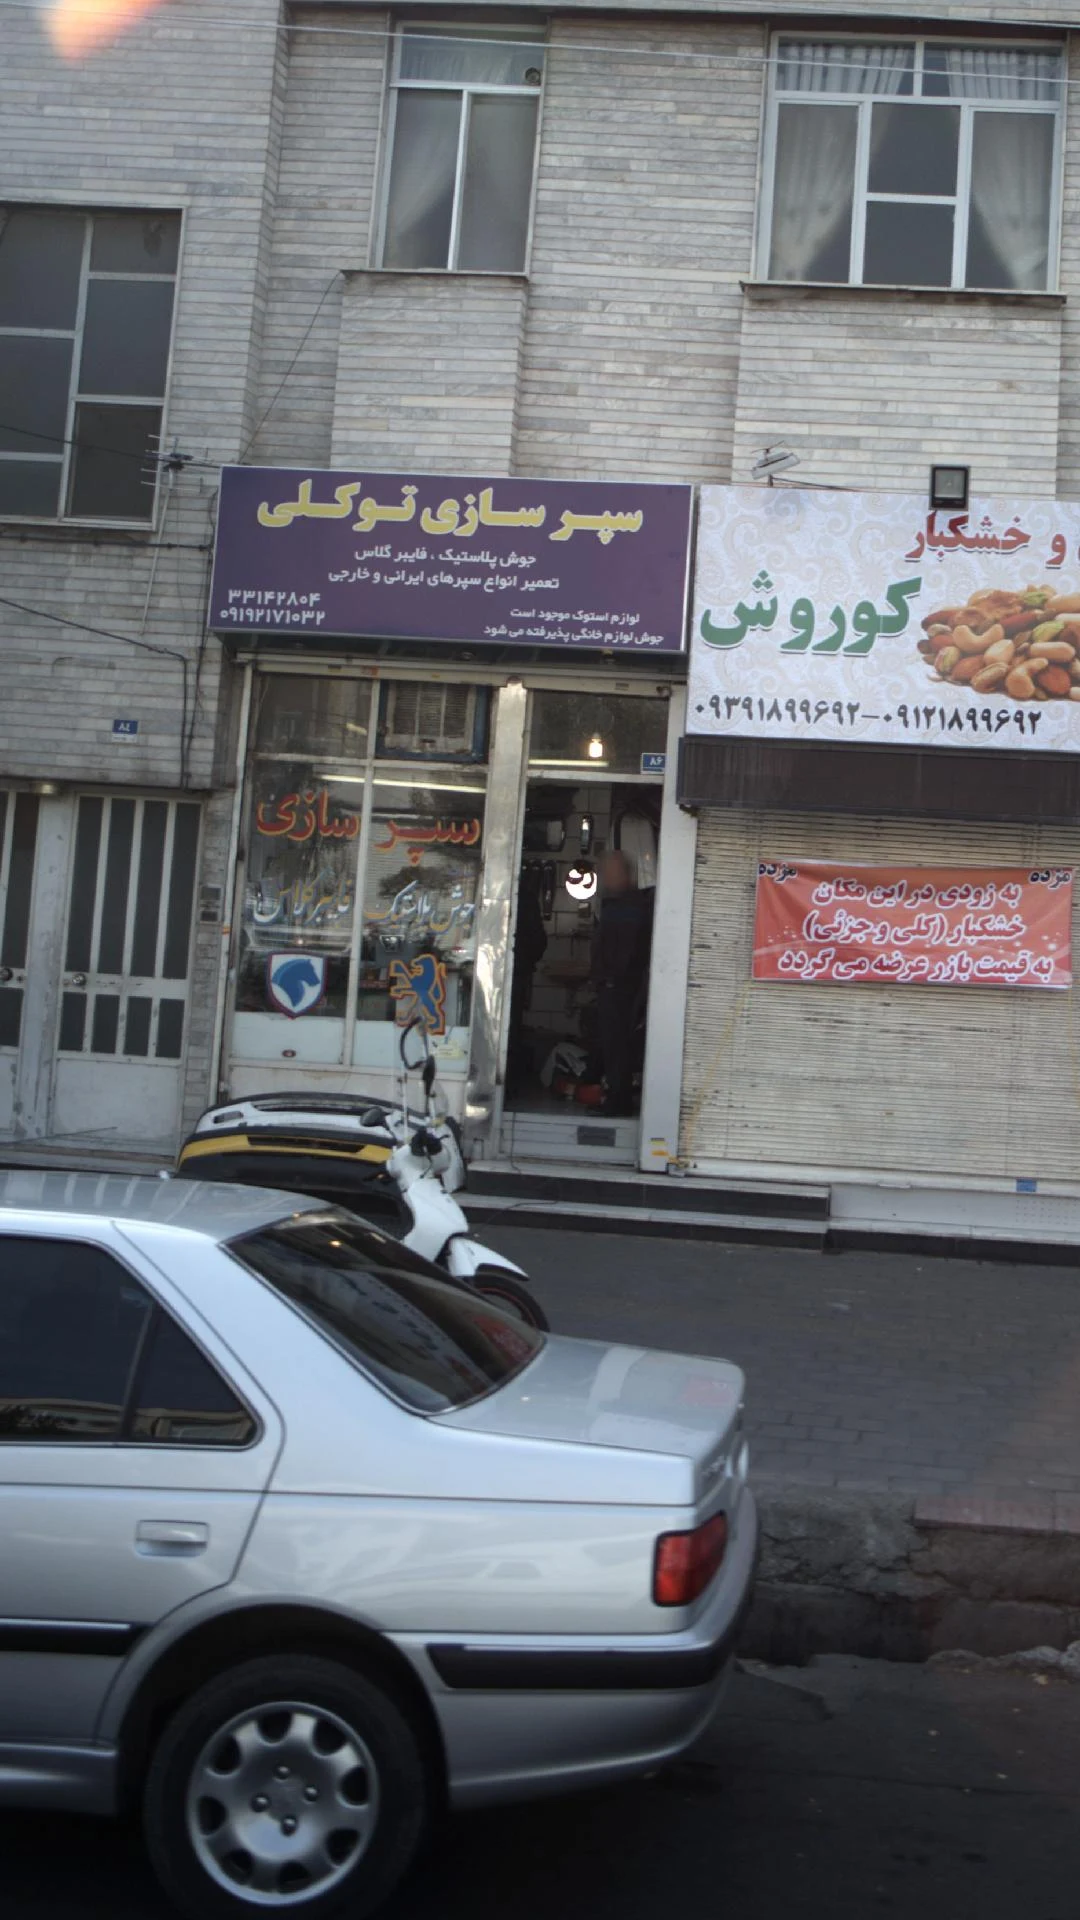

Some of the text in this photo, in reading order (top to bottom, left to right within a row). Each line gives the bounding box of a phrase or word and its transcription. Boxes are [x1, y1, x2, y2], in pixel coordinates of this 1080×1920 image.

[256, 478, 643, 545] سپر سازی توکلی
[903, 511, 1032, 561] خشکبار
[354, 544, 392, 561] گلاس
[393, 547, 427, 563] فایبر
[438, 548, 498, 569] پلاستیک
[499, 552, 537, 568] جوش
[328, 567, 560, 592] تعمیر انواع سپرهای ایرانی و خارجی
[227, 589, 321, 607] ۳۳۱۴۲۸۰۴
[220, 606, 326, 626] ۰۹۱۹۲۱۷۱۰۳۲
[510, 608, 640, 626] لوازم استوک موجود است
[700, 569, 923, 656] کوروش
[483, 624, 664, 645] جوش لوازم خانگی پذیرفته می شود
[256, 789, 480, 866] سپر سازی
[758, 863, 798, 882] مژده
[1029, 870, 1072, 889] مژده
[812, 878, 1021, 909] به زودی در این مکان
[947, 914, 1027, 946] خشکبار
[778, 948, 835, 979] گردد
[832, 956, 869, 979] می
[872, 951, 929, 981] عرضه
[973, 951, 1030, 982] قیمت
[1031, 956, 1054, 983] به
